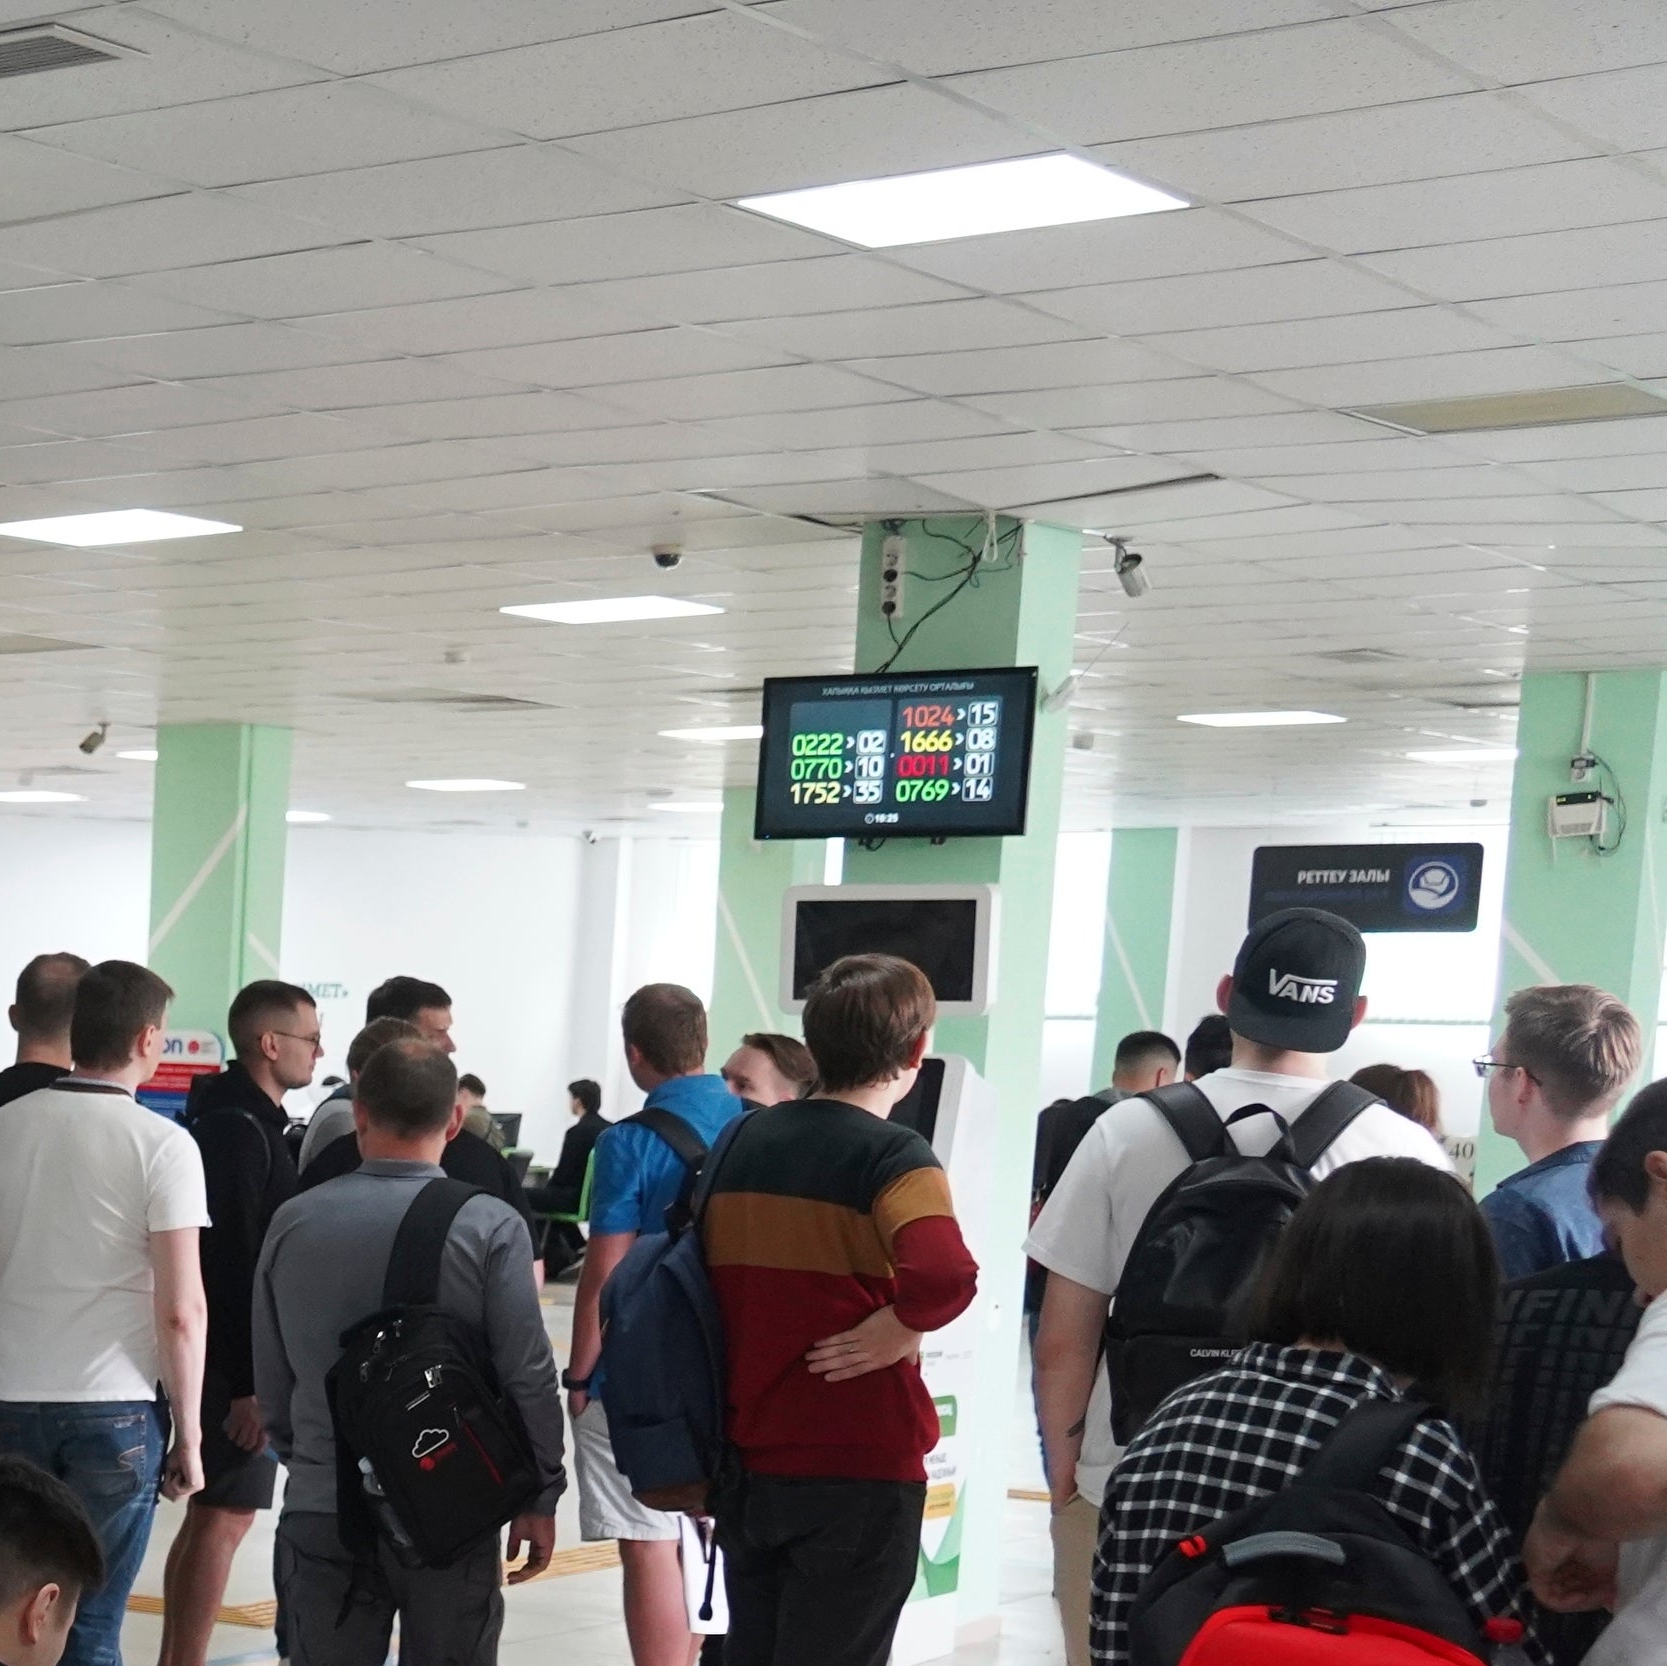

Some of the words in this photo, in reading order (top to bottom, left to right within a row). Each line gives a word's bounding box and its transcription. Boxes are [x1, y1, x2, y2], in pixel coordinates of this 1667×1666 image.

[902, 705, 954, 727] 1024
[970, 703, 996, 724] 15
[792, 733, 843, 756] 0222
[859, 732, 884, 753] 02
[901, 730, 953, 753] 1666
[968, 729, 995, 750] 08
[791, 758, 842, 780] 0770
[857, 758, 883, 777] 10
[897, 754, 949, 776] 0011
[966, 754, 992, 774] 01
[790, 781, 841, 804] 1752
[855, 781, 881, 802] 35
[895, 779, 949, 802] 0769
[965, 778, 991, 799] 14
[1297, 869, 1347, 885] РЕТТЕУ
[1349, 868, 1391, 883] ЗАЛЫ
[1269, 968, 1338, 1004] VANS
[1190, 1348, 1219, 1358] CALVIN
